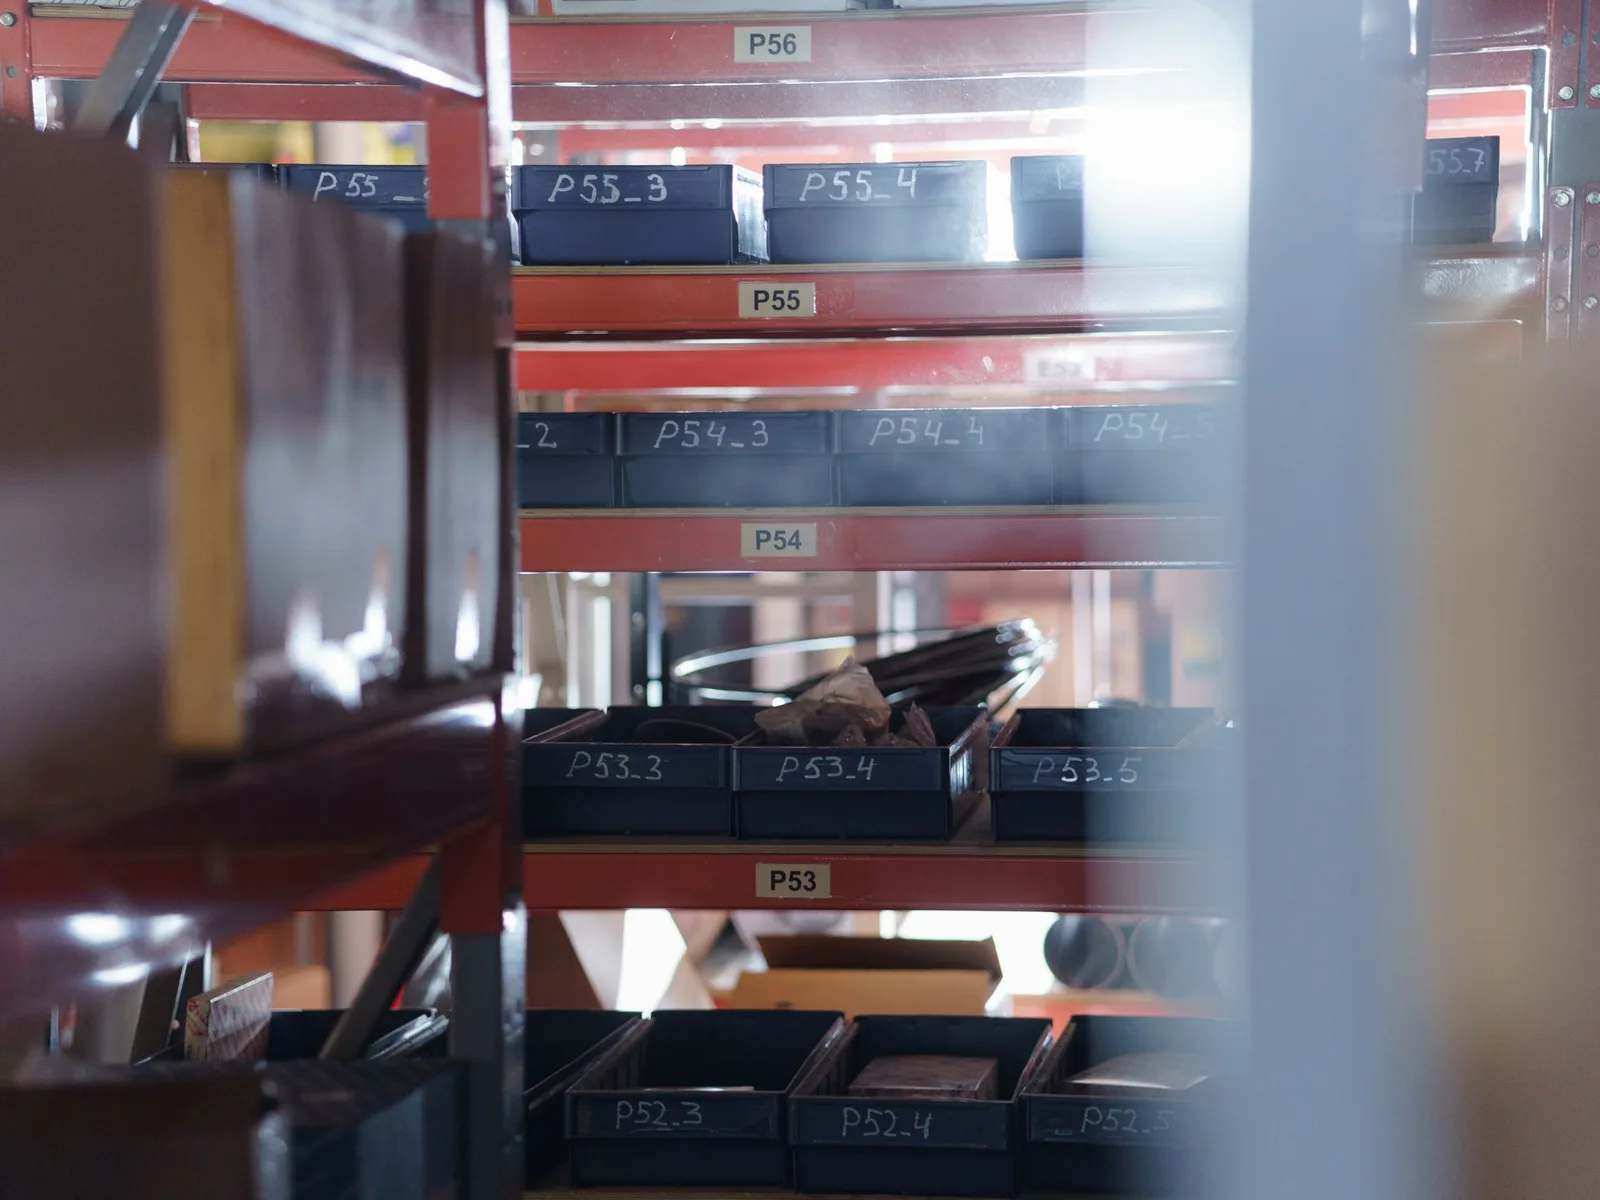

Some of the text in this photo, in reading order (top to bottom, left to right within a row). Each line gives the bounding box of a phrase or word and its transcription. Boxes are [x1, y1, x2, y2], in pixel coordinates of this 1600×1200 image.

[749, 33, 797, 55] P56
[548, 173, 668, 204] P55_3
[799, 168, 917, 201] P55_4
[753, 289, 801, 311] P55
[654, 420, 769, 448] P54_3
[869, 416, 984, 446] P54_4
[755, 529, 802, 551] P54
[566, 751, 663, 780] P53_3
[776, 756, 876, 782] P53_4
[1032, 757, 1142, 783] P53_5
[770, 870, 817, 891] P53
[616, 1101, 702, 1129] P52_3
[842, 1107, 933, 1139] P52_4
[1080, 1106, 1175, 1133] P52_5
